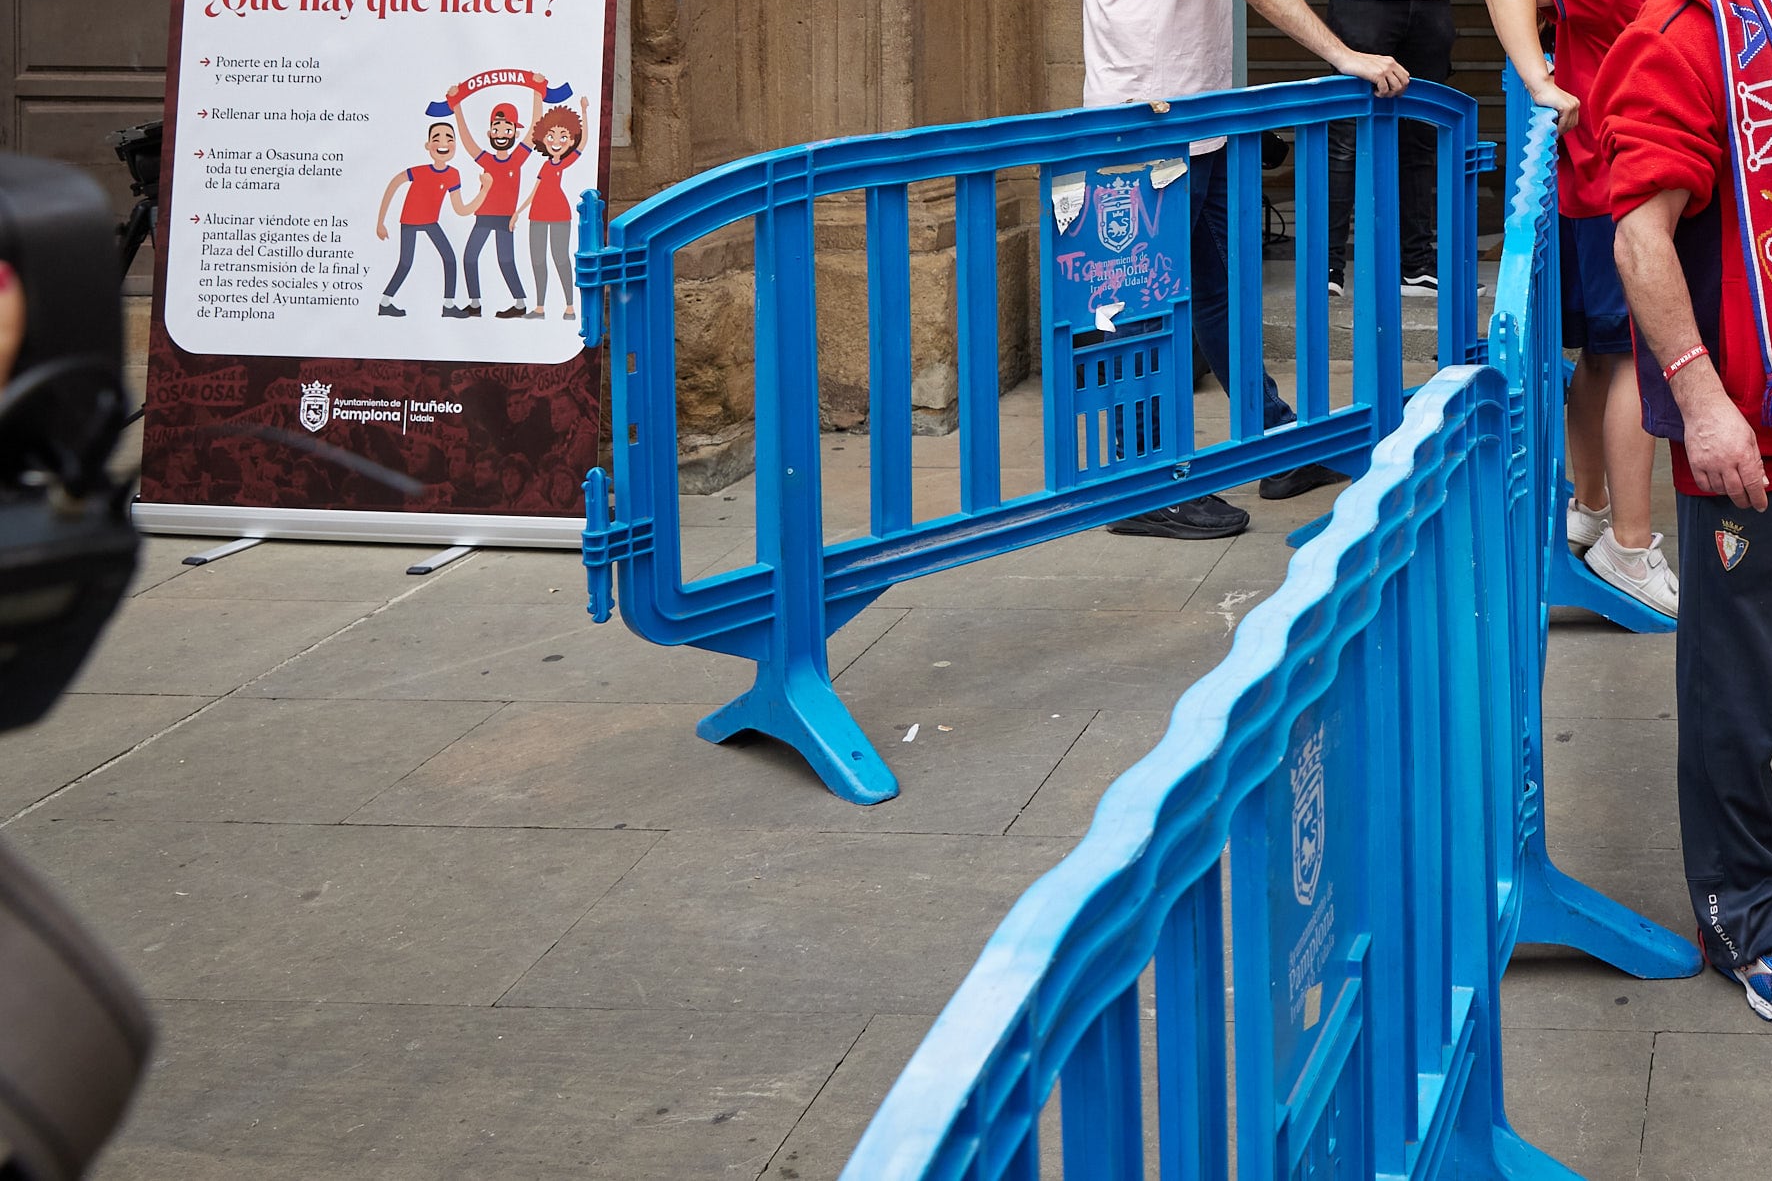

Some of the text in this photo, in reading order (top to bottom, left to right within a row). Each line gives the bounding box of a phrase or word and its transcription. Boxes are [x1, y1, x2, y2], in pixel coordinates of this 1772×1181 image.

[216, 56, 320, 69] Ponerte en la cola
[215, 73, 322, 86] y esperar tu turno
[467, 71, 526, 90] OSASUNA
[211, 109, 370, 123] Rellenar una hoja de datos
[207, 149, 344, 162] Animar a Osasuna con
[205, 164, 343, 179] toda tu energía delante
[205, 177, 280, 191] de la cámara
[203, 213, 348, 227] Alucinar viéndote en las
[202, 229, 341, 244] pantallas gigantes de la
[202, 244, 354, 259] Plaza del Castillo durante
[200, 260, 370, 277] la retransmisión de la final y
[199, 275, 363, 291] en las redes sociales y otros
[198, 292, 360, 306] soportes del Ayuntamiento
[197, 307, 275, 321] de Pamplona
[334, 398, 401, 408] Ayuntamiento de
[410, 400, 463, 413] Iruñeko
[332, 408, 400, 424] Pamplona
[410, 414, 434, 422] Udala
[1708, 894, 1738, 960] OSASUNA
[1289, 903, 1335, 1002] Pamplona
